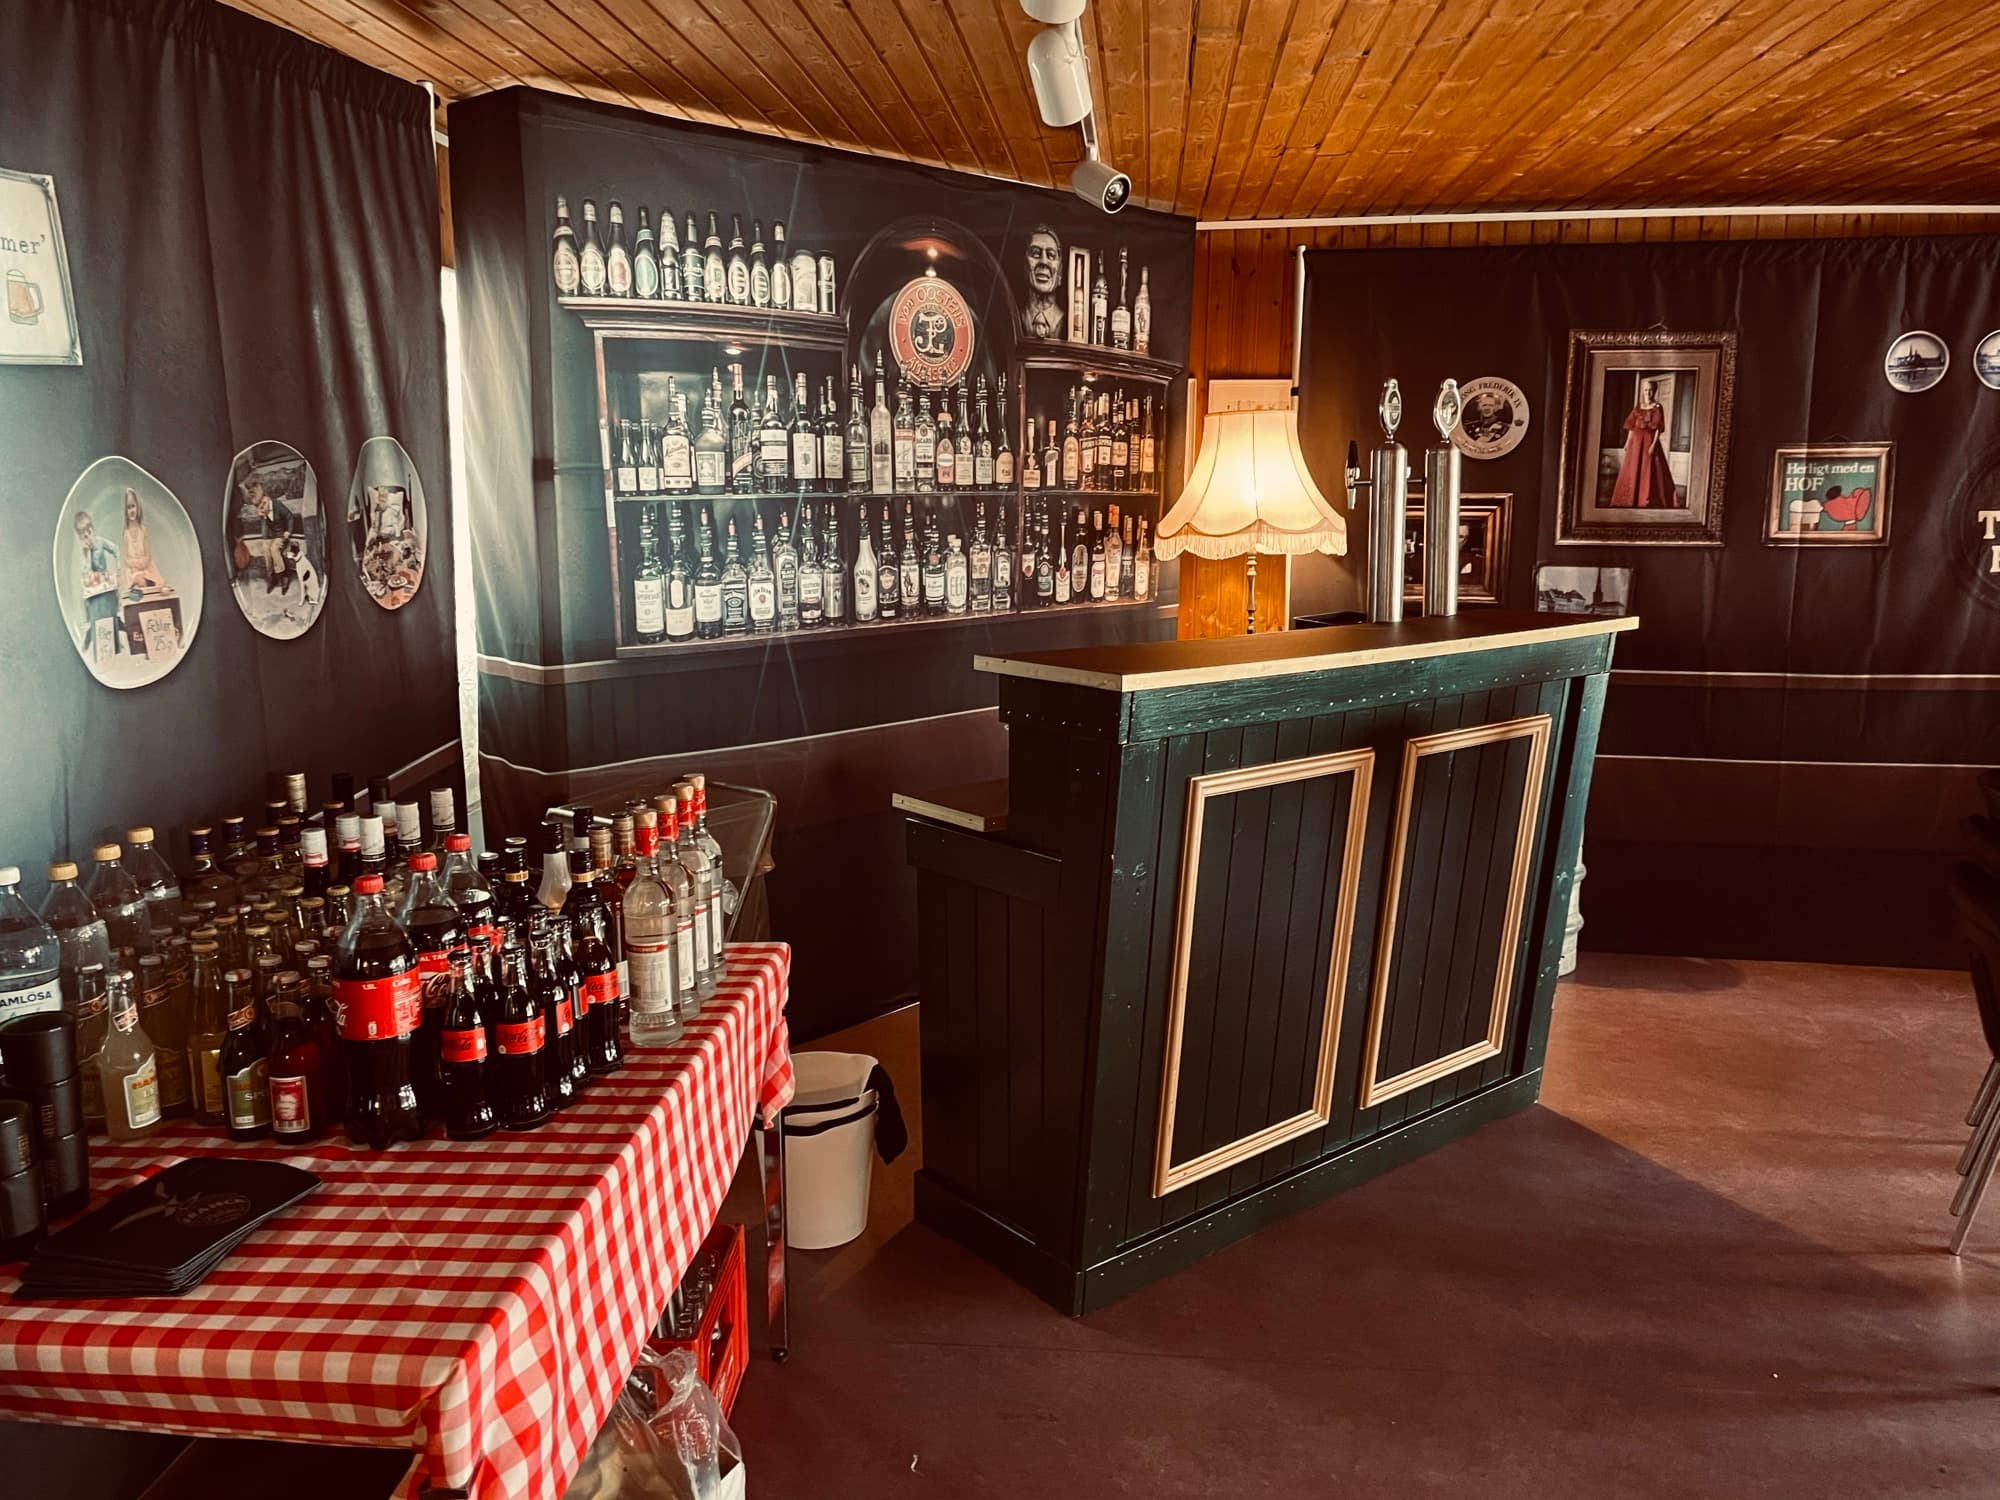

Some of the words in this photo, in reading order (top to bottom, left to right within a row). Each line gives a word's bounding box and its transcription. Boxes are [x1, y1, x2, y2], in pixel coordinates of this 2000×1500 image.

[1786, 462, 1830, 476] Herligt
[1832, 462, 1859, 474] med
[1860, 464, 1875, 473] en
[1784, 477, 1825, 492] HOF
